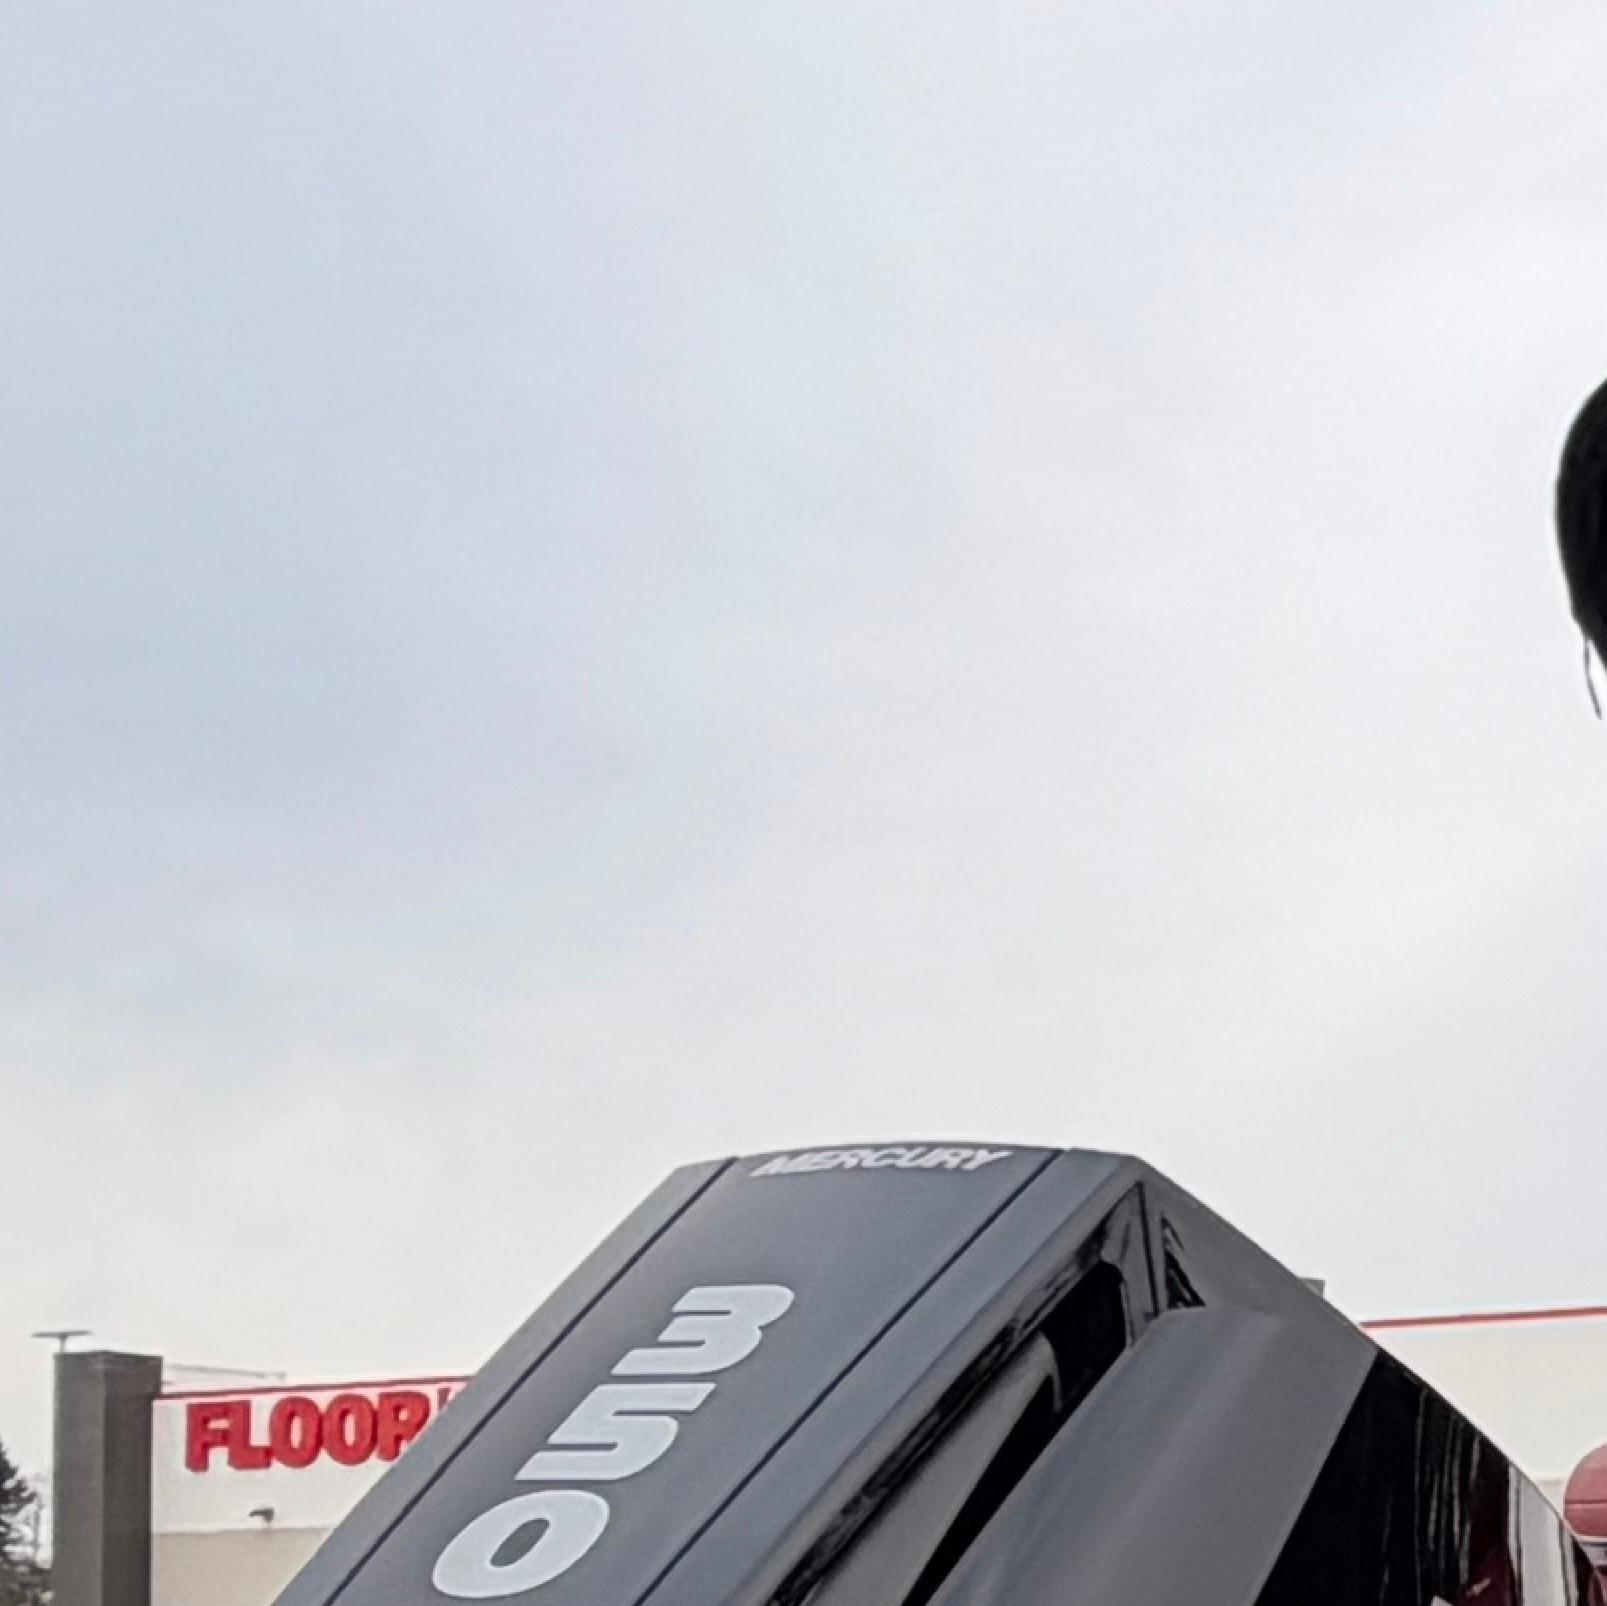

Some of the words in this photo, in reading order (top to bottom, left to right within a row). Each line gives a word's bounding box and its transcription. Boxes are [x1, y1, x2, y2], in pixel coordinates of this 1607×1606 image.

[749, 1147, 1014, 1177] MERCURY
[185, 1386, 450, 1472] FLOOR
[432, 1284, 795, 1598] 350
